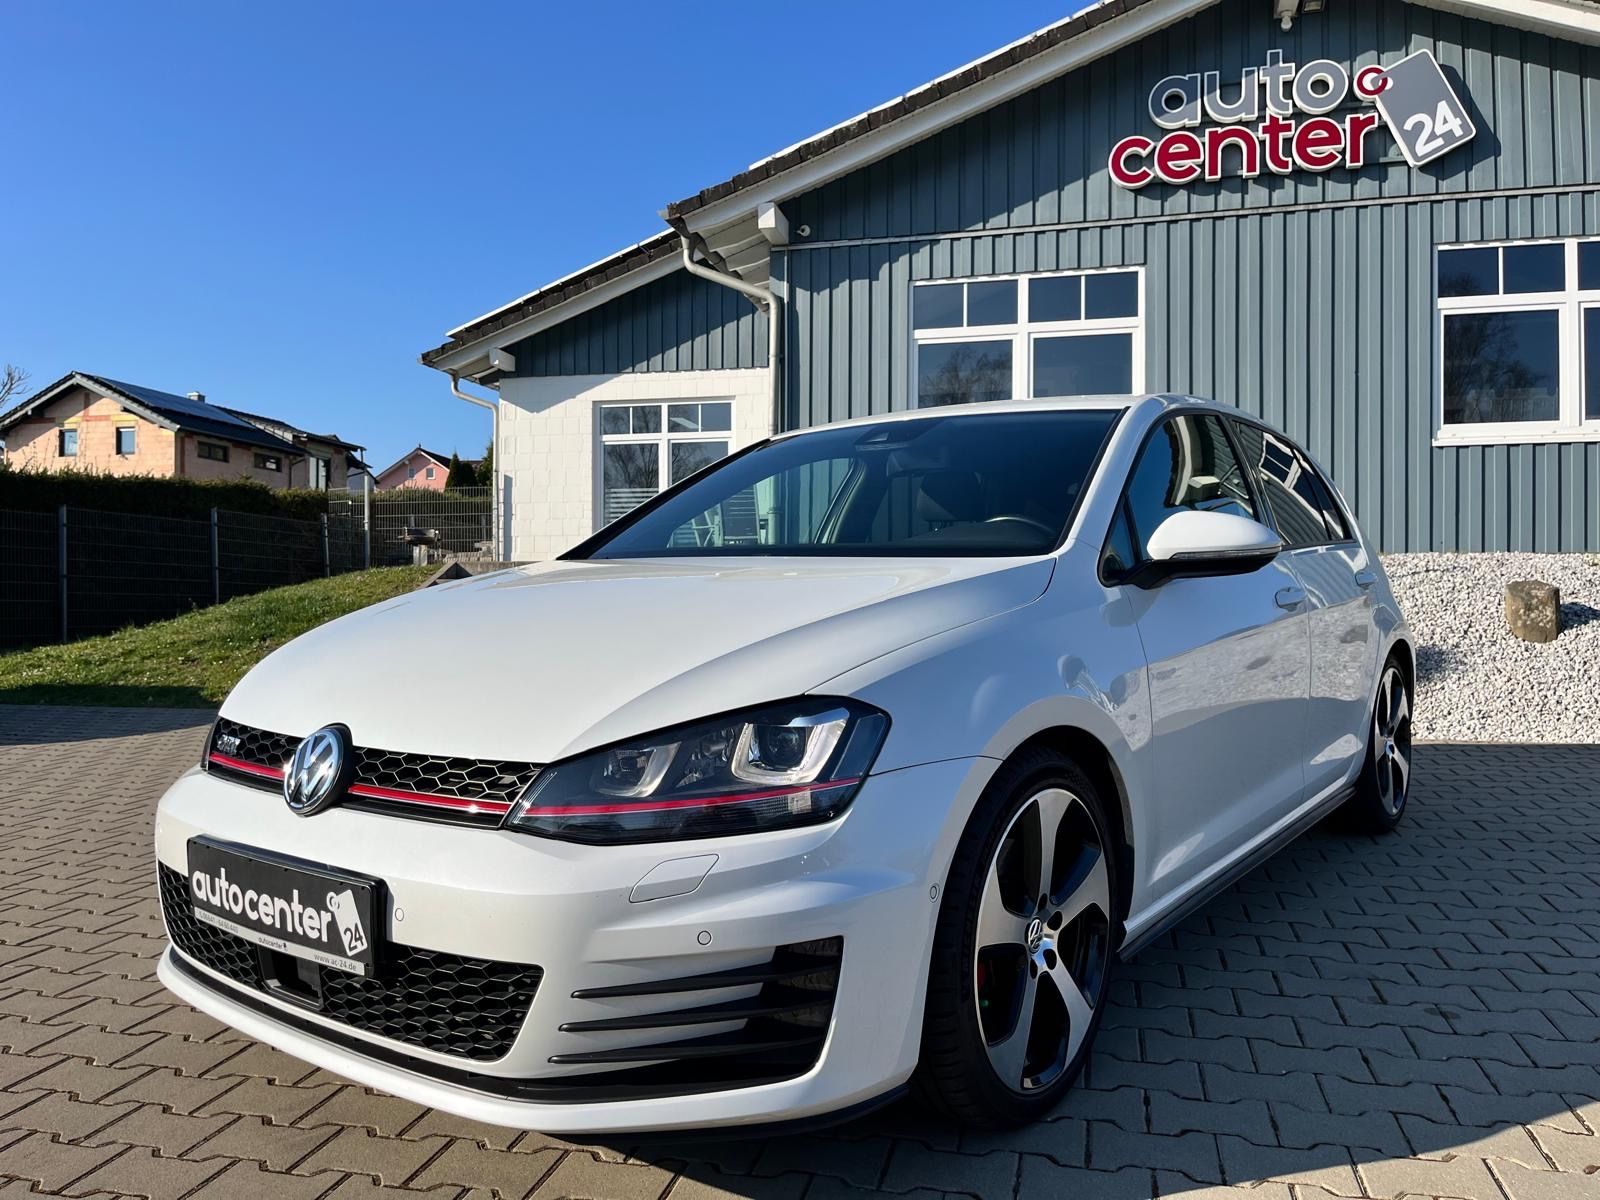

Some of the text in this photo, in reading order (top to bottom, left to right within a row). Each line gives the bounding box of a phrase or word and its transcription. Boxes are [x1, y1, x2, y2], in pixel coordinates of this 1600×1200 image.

[1148, 49, 1349, 129] auto
[1108, 100, 1464, 190] center 24
[192, 867, 332, 943] autocenter
[343, 922, 364, 951] 24
